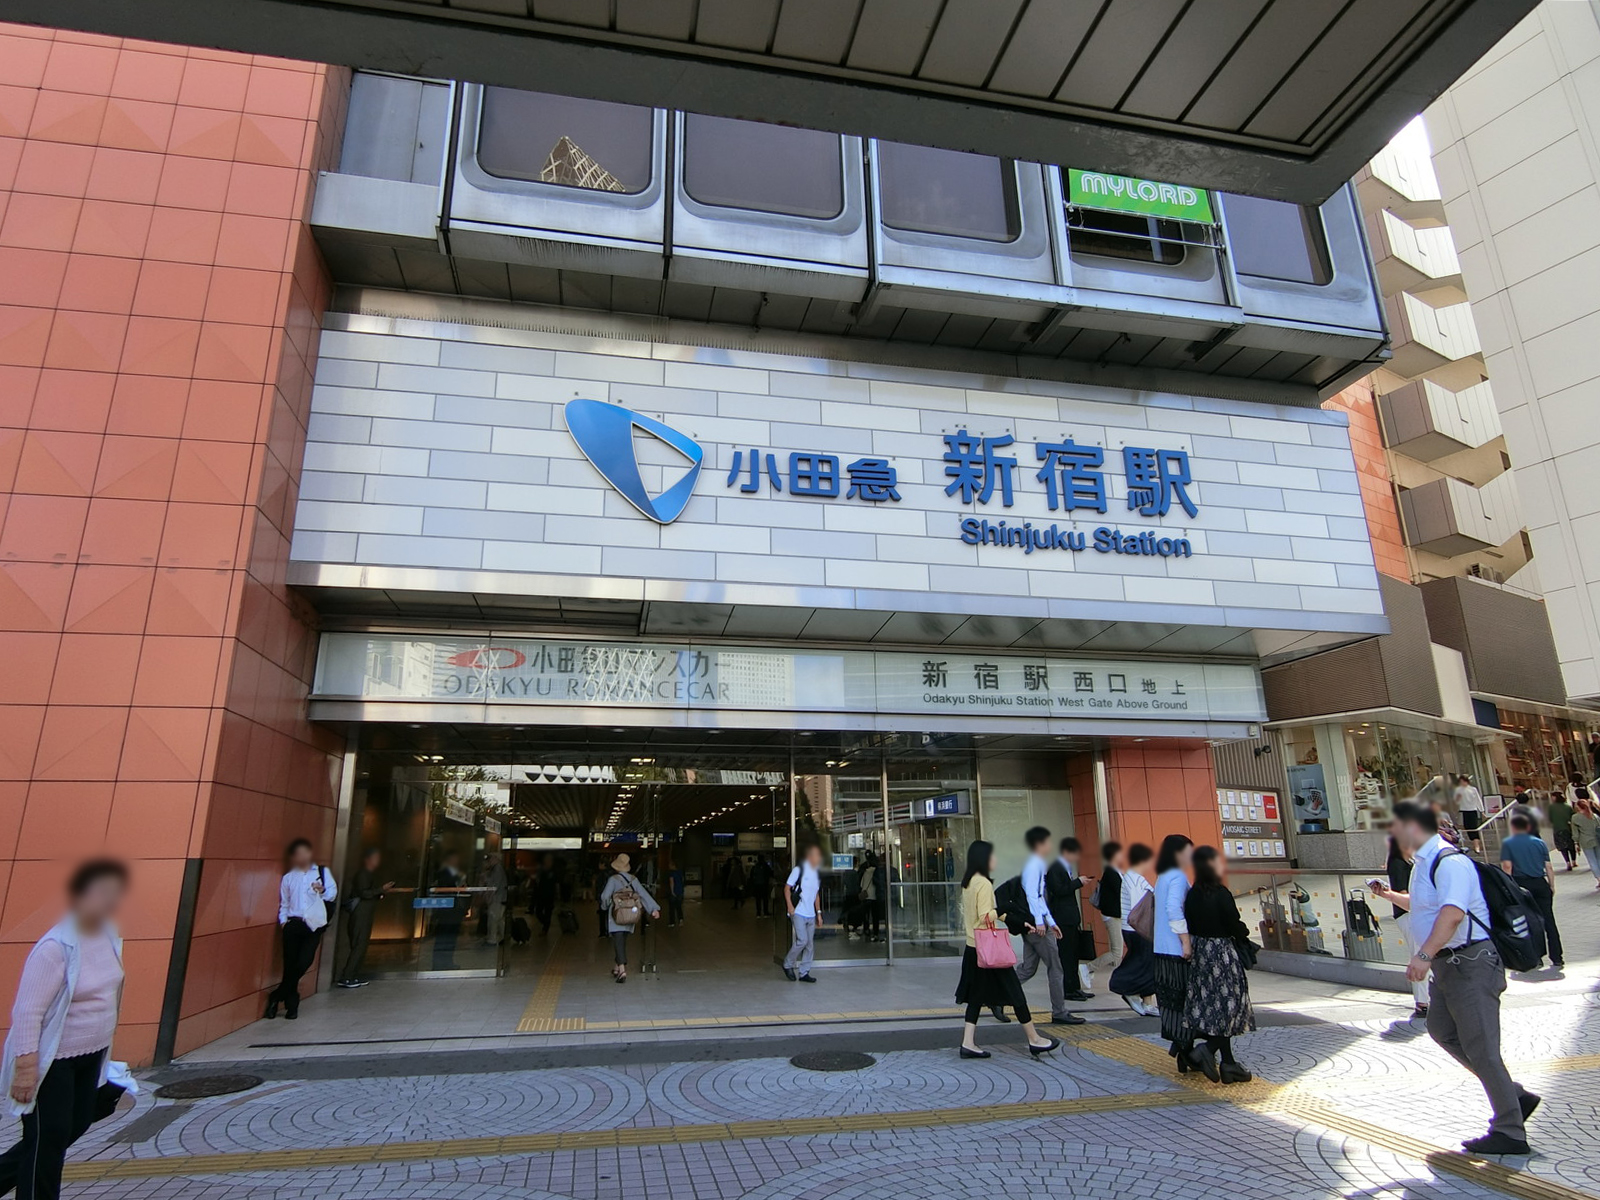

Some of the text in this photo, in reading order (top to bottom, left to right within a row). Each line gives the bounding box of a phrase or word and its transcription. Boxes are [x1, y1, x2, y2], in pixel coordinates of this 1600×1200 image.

[1081, 173, 1197, 206] MYLORD
[727, 429, 1199, 519] 小田急 新宿駅
[960, 518, 1193, 558] Shinjuku Station
[443, 674, 731, 701] ODAKYU ROMANCECAR
[923, 693, 1188, 710] Odakyu Shinjuku Station West Gate Above Ground
